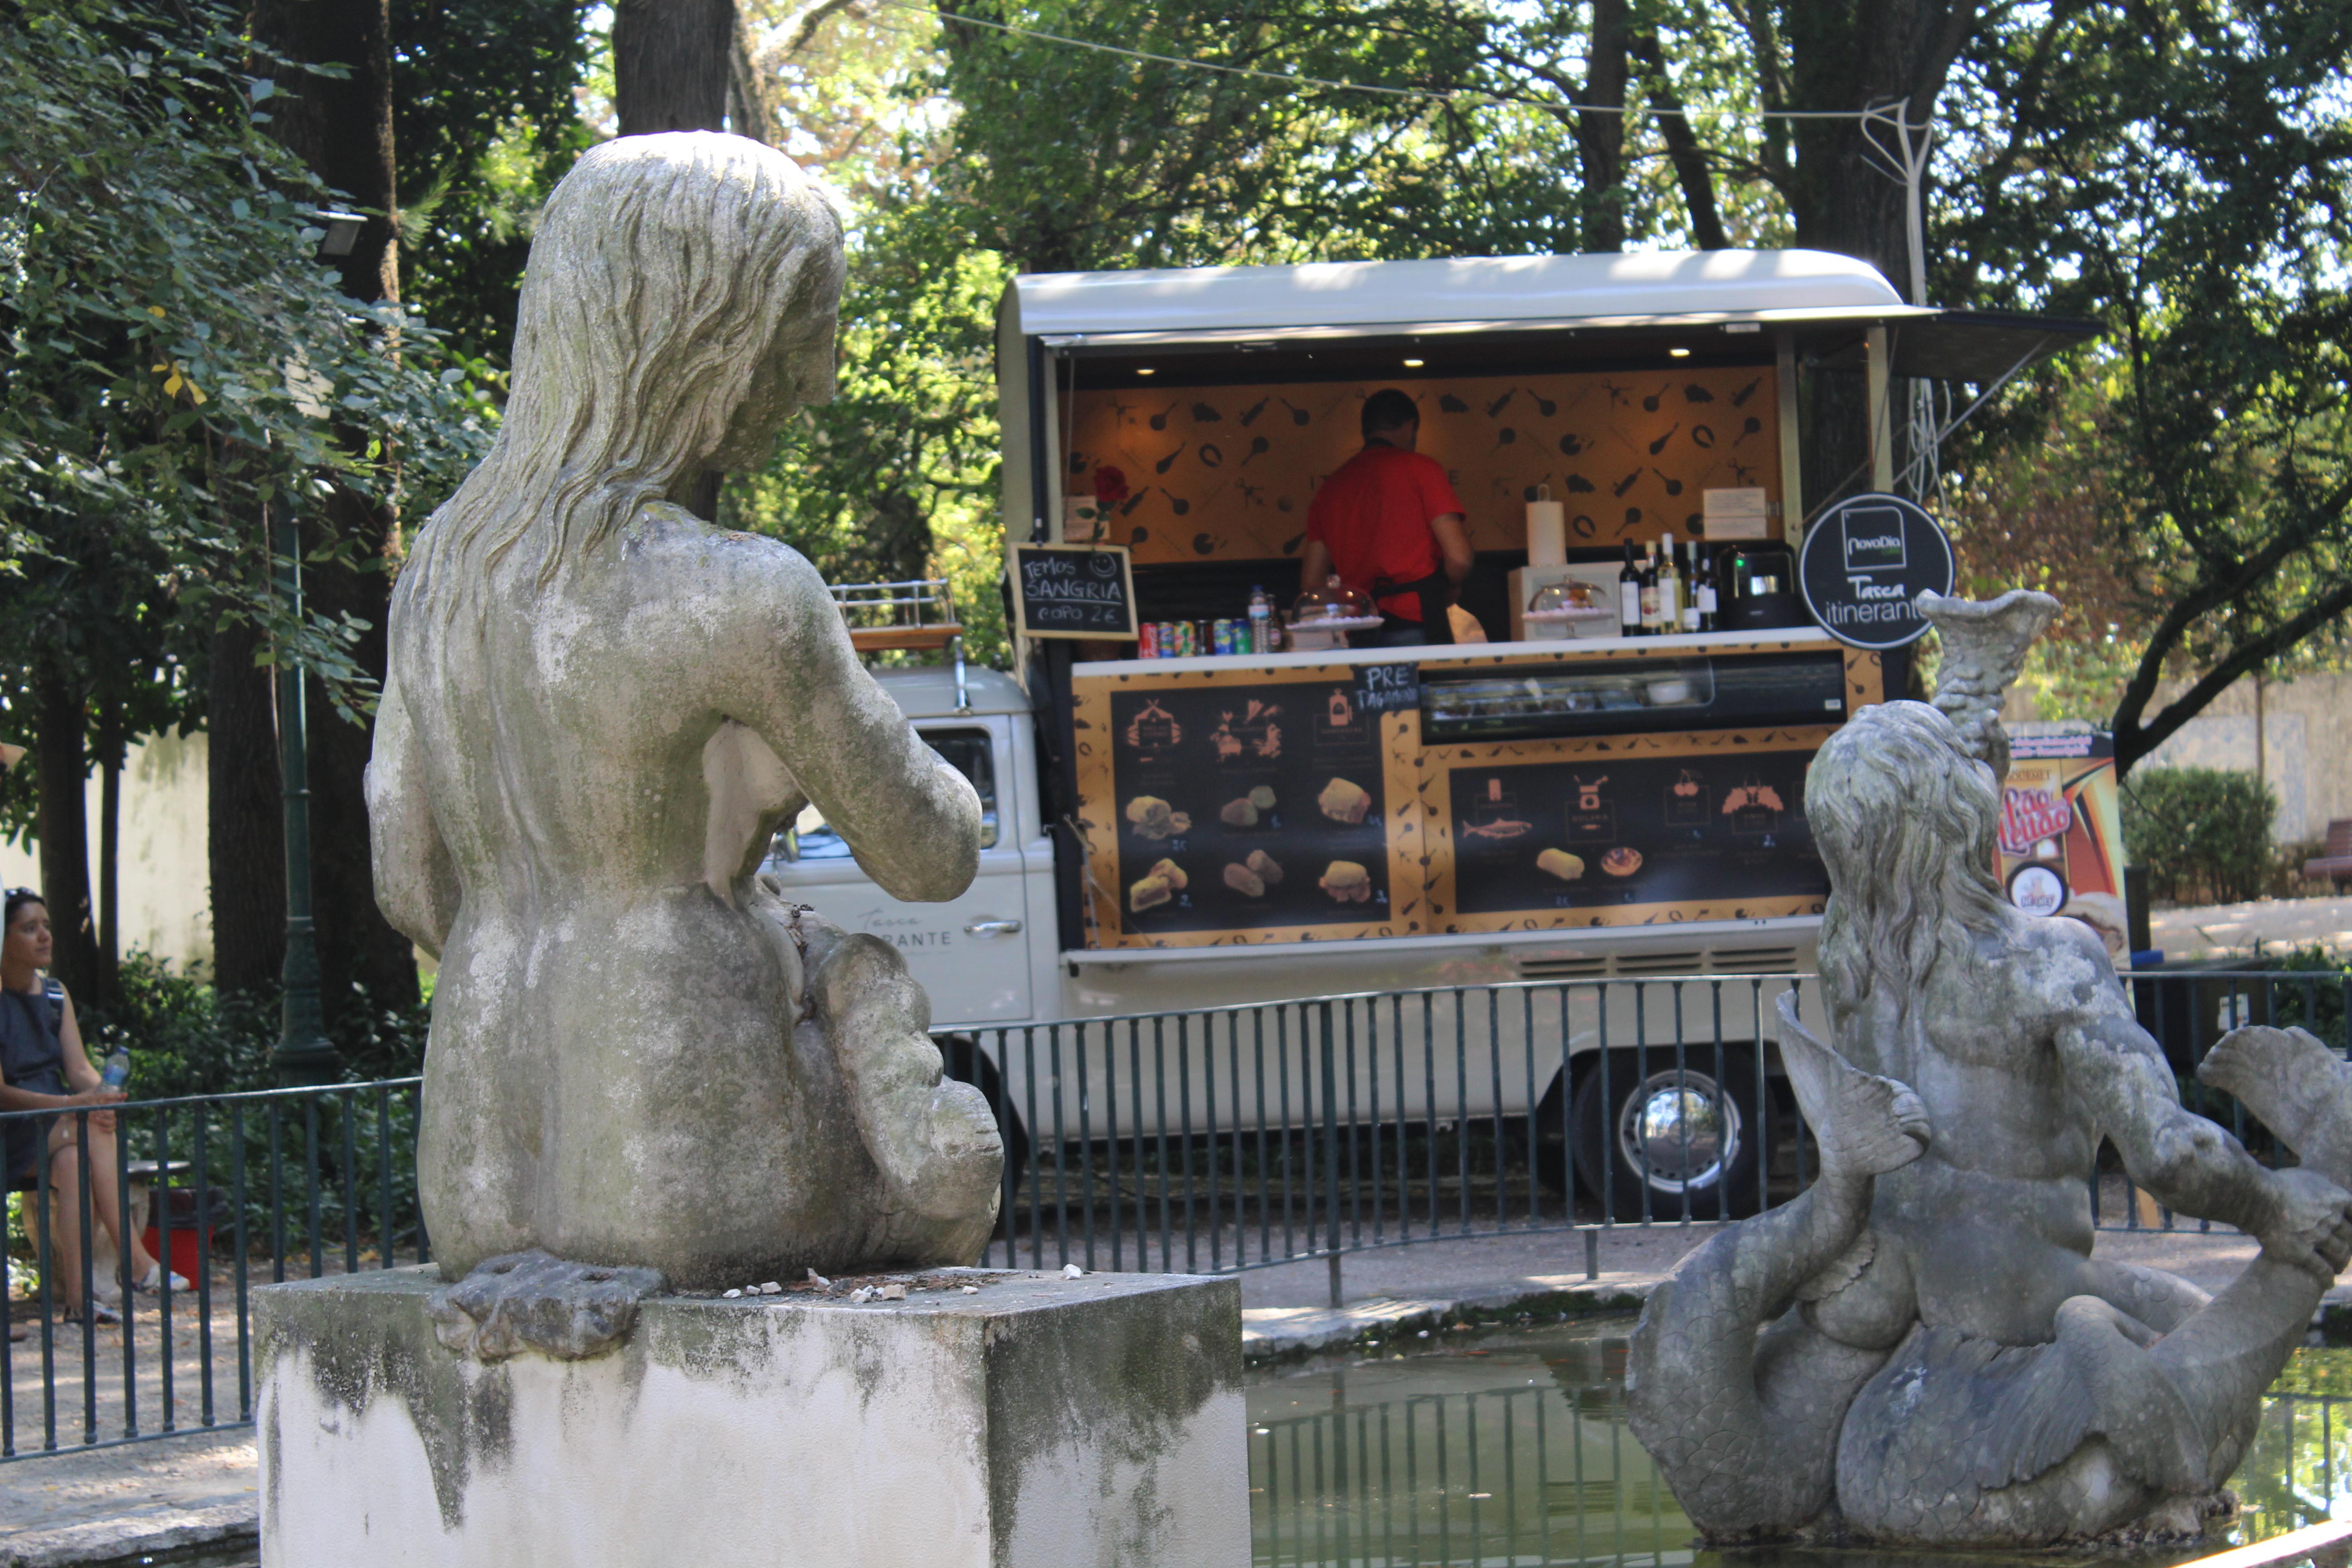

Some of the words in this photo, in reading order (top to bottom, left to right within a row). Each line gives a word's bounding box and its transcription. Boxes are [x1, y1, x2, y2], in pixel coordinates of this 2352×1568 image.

[1024, 557, 1075, 578] TEMOS
[1025, 579, 1121, 599] SANGRIA
[1847, 574, 1905, 599] Tasca
[858, 907, 922, 930] Tasca
